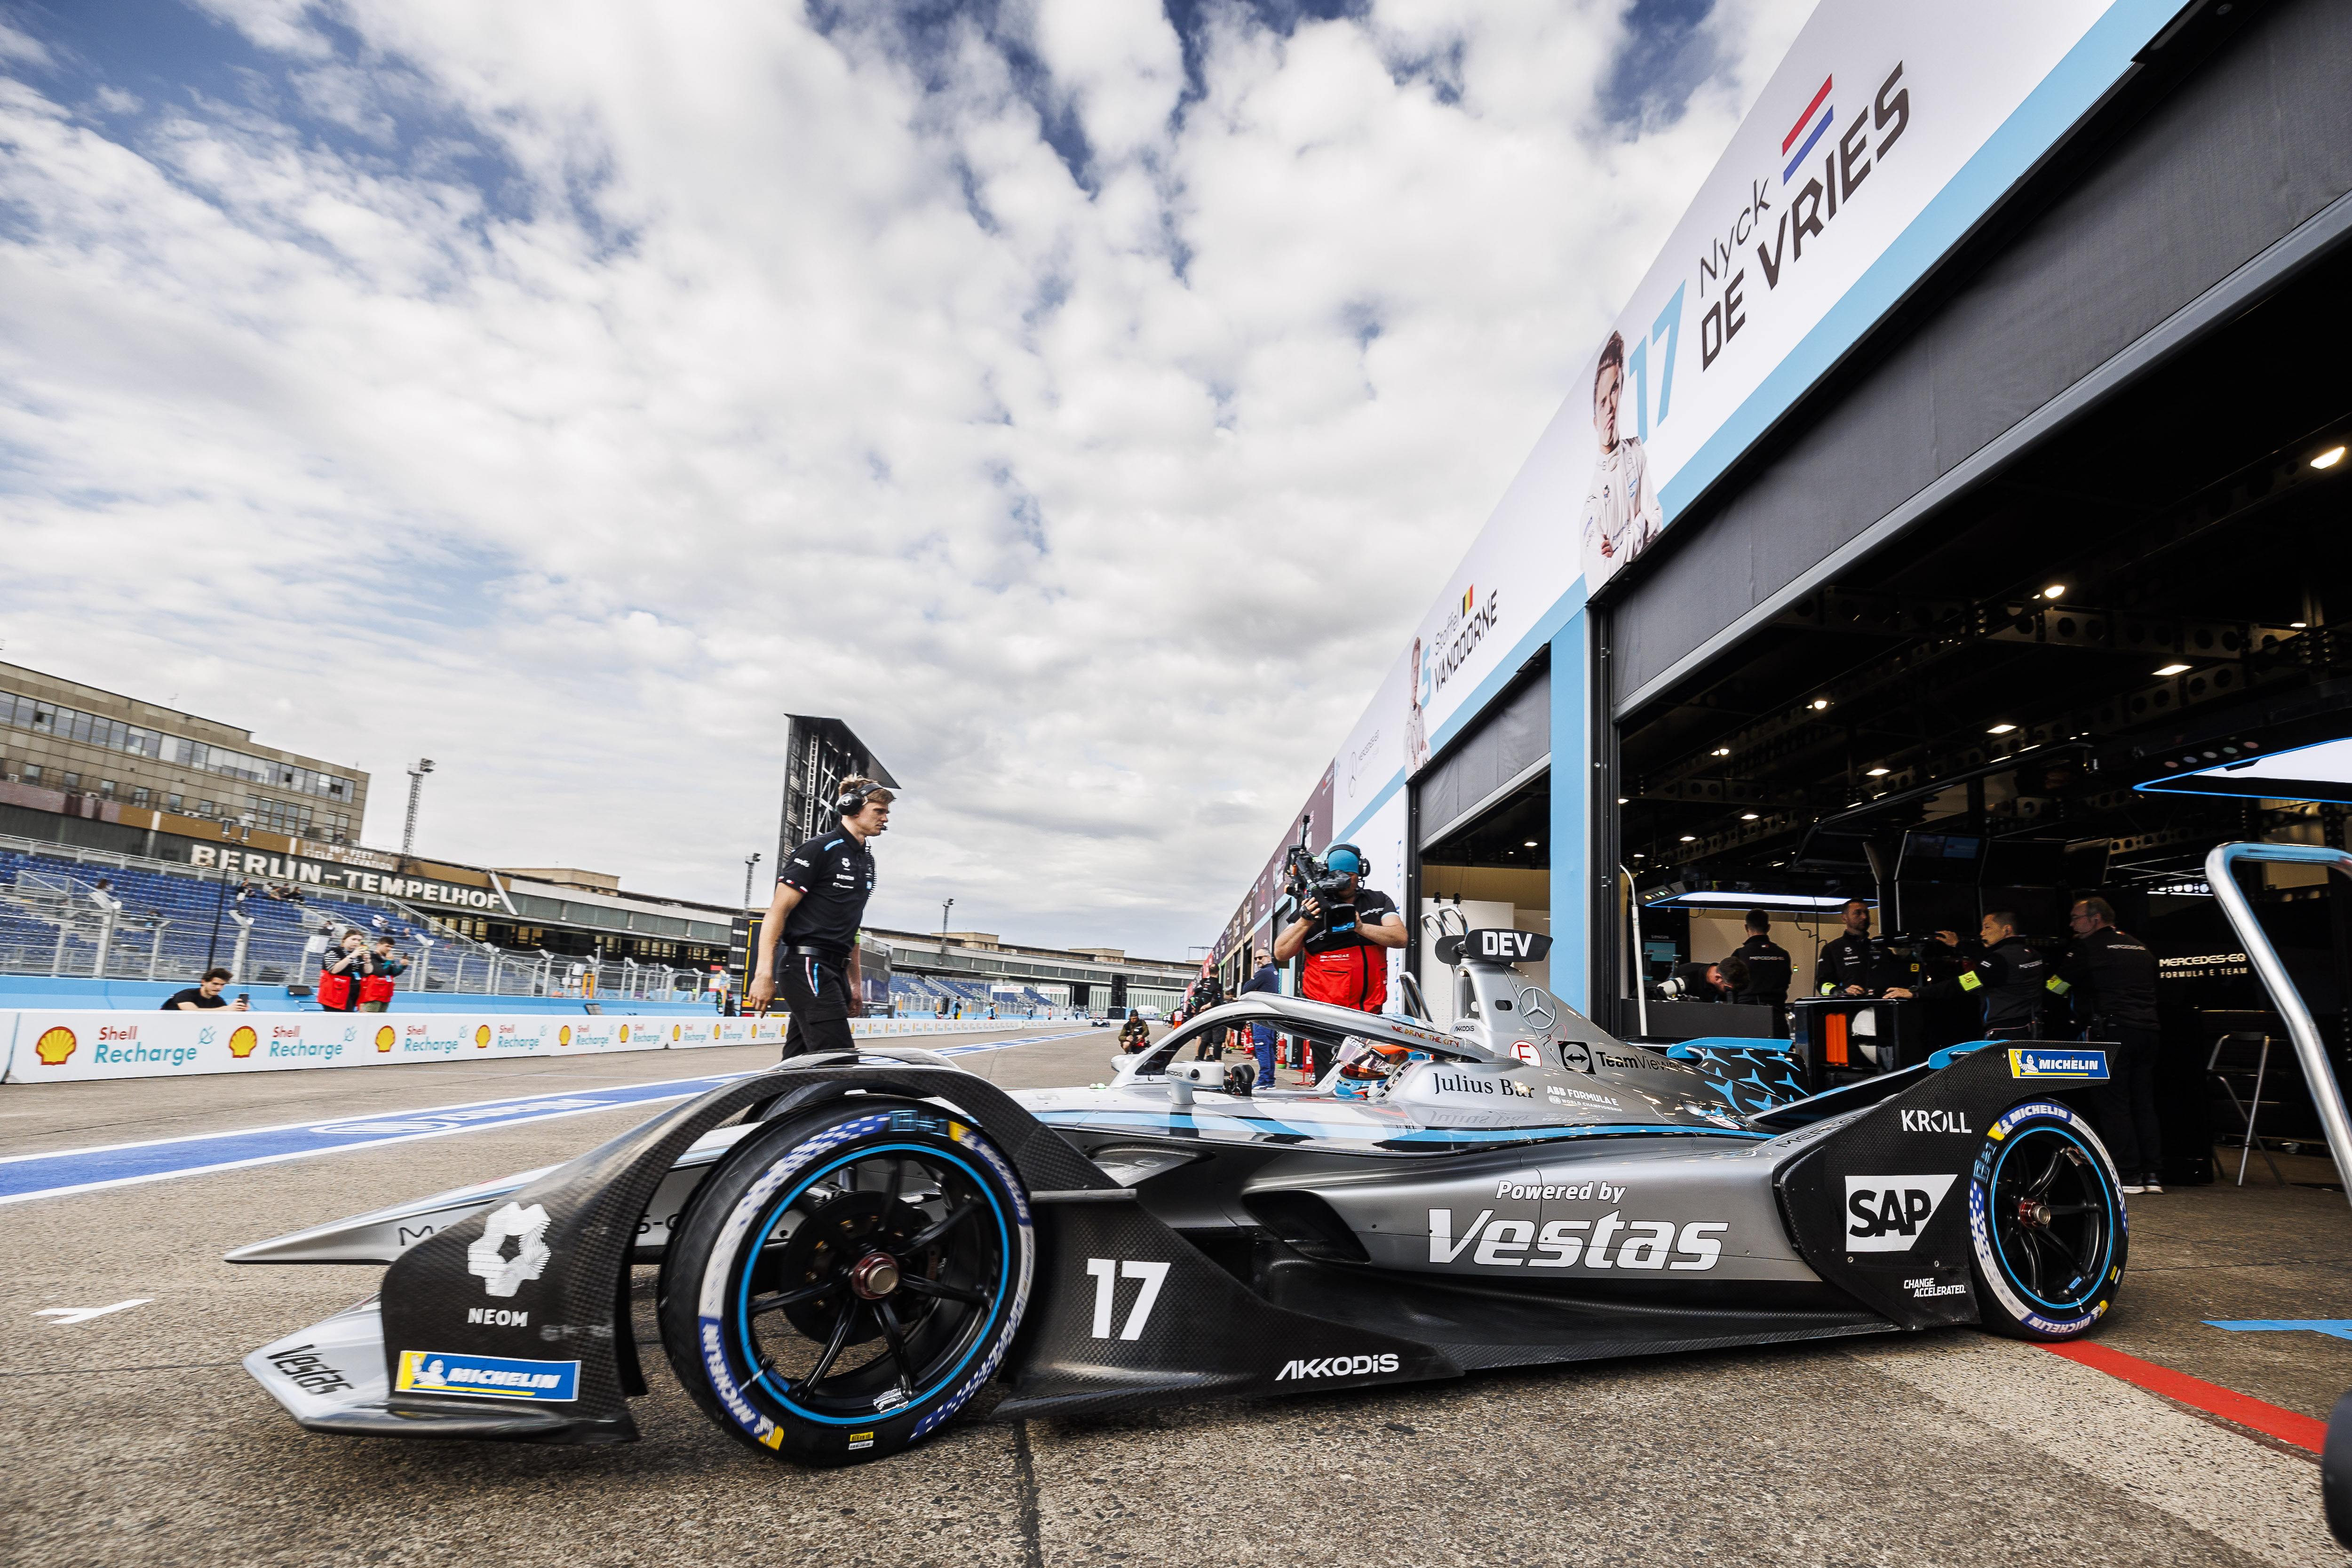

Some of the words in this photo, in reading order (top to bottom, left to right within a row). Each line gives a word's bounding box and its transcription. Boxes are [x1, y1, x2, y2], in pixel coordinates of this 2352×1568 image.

[1701, 267, 1746, 373] DE
[1757, 59, 1911, 291] VRIES
[1699, 177, 1771, 299] Nyck
[1629, 279, 1686, 445] 17
[1435, 603, 1460, 656] Stoffel
[1435, 588, 1497, 693] VANDOORNE
[1421, 643, 1431, 710] 5
[1482, 931, 1533, 957] DEV
[2158, 953, 2247, 967] MERCEDES-EQ
[2160, 970, 2204, 979] FORMULA
[2221, 967, 2249, 976] TEAM
[99, 1026, 138, 1040] Shell
[273, 1026, 301, 1038] Shell
[406, 1025, 428, 1035] Shell
[499, 1024, 515, 1034] Shell
[1391, 1025, 1403, 1033] WE
[1429, 1035, 1442, 1043] THE
[1443, 1038, 1459, 1048] CITY
[269, 1039, 343, 1060] Recharge
[404, 1038, 460, 1054] Recharge
[497, 1035, 540, 1050] Recharge
[576, 1034, 609, 1047] Recharge
[94, 1041, 197, 1066] Recharge
[1595, 1051, 1683, 1073] TeamViewer
[2039, 1059, 2098, 1070] MICHELIN
[1433, 1073, 1494, 1095] Julius
[1546, 1085, 1566, 1097] ABB
[1567, 1088, 1612, 1105] FORMULA
[1611, 1098, 1620, 1106] E
[1582, 1101, 1623, 1112] CHAMPIONSHIP
[2009, 1105, 2068, 1125] MICHELIN
[1901, 1109, 1972, 1133] KROLL
[1495, 1180, 1595, 1201] Powered
[1597, 1181, 1627, 1204] by
[1848, 1189, 1932, 1238] SAP
[1428, 1208, 1730, 1271] Vestas
[1904, 1278, 1936, 1289] CHANGE.
[1913, 1284, 1966, 1298] ACCELERATED.
[1087, 1258, 1171, 1341] 17
[467, 1307, 529, 1327] NEOM
[2027, 1316, 2092, 1333] MICHELIN
[266, 1344, 354, 1396] Vestas
[447, 1368, 561, 1389] MICHELIN
[702, 1323, 757, 1425] MICHELIN
